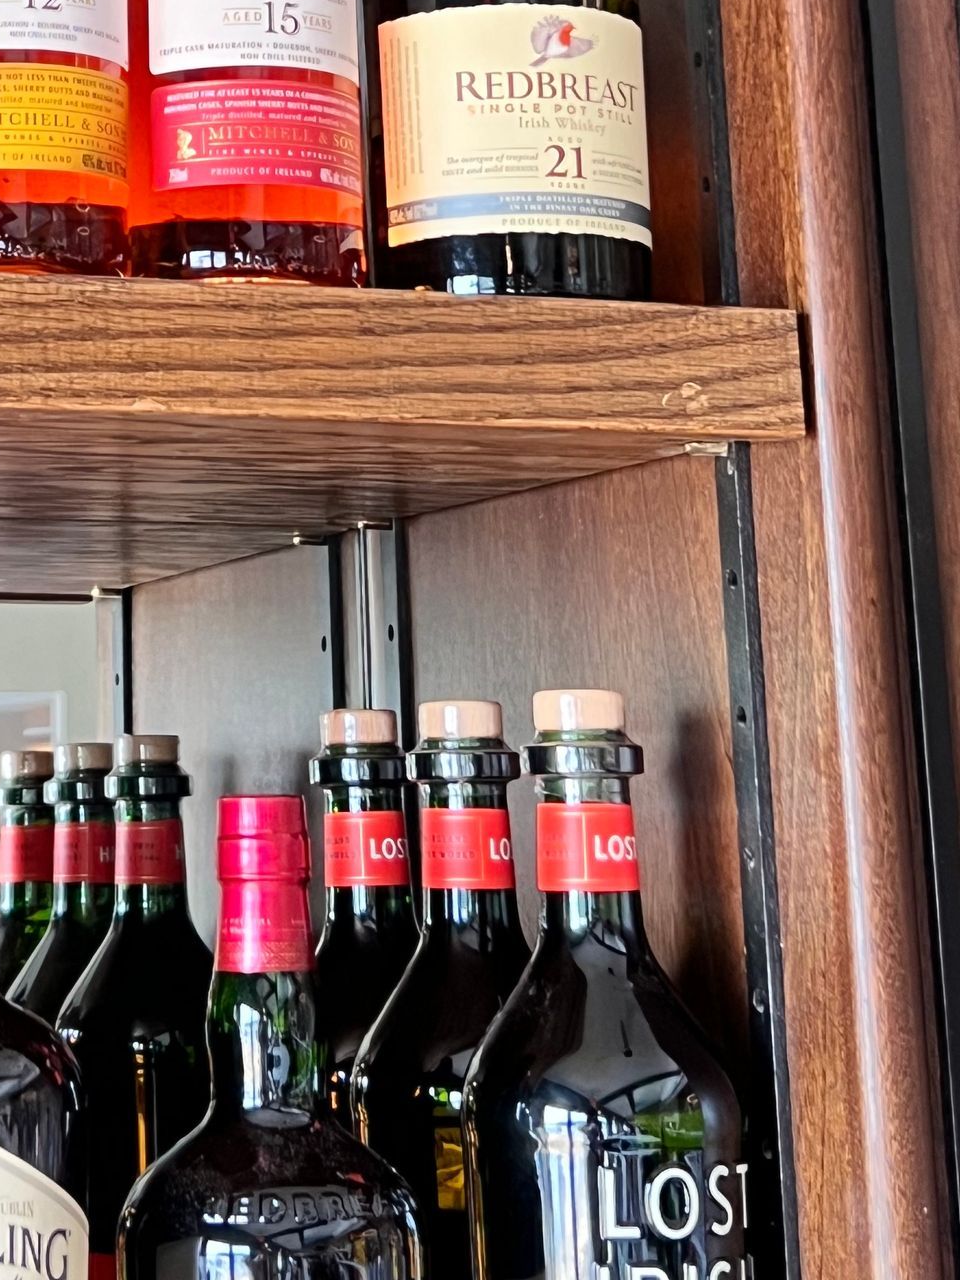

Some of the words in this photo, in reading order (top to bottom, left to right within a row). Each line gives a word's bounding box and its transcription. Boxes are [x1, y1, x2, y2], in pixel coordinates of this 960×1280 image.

[223, 11, 262, 21] AGED
[264, 1, 300, 35] 15
[302, 15, 332, 30] YEARS
[208, 42, 263, 50] MATURATION
[49, 75, 69, 83] THAN
[14, 85, 45, 93] SHERRY
[49, 86, 73, 95] BUTTS
[455, 71, 638, 112] REDBREAST
[467, 103, 541, 116] SINGLE
[554, 104, 587, 116] POT
[597, 108, 632, 125] STILL
[82, 118, 90, 131] &
[519, 117, 549, 130] Irish
[555, 117, 606, 136] Whiskey
[208, 126, 312, 143] MITCHELL
[319, 132, 328, 144] &
[30, 153, 72, 163] IRELAND
[544, 144, 587, 180] 21
[211, 167, 254, 175] PRODUCT
[275, 167, 312, 178] IRELAND
[586, 220, 626, 232] IRELAND
[598, 1163, 748, 1240] LOST
